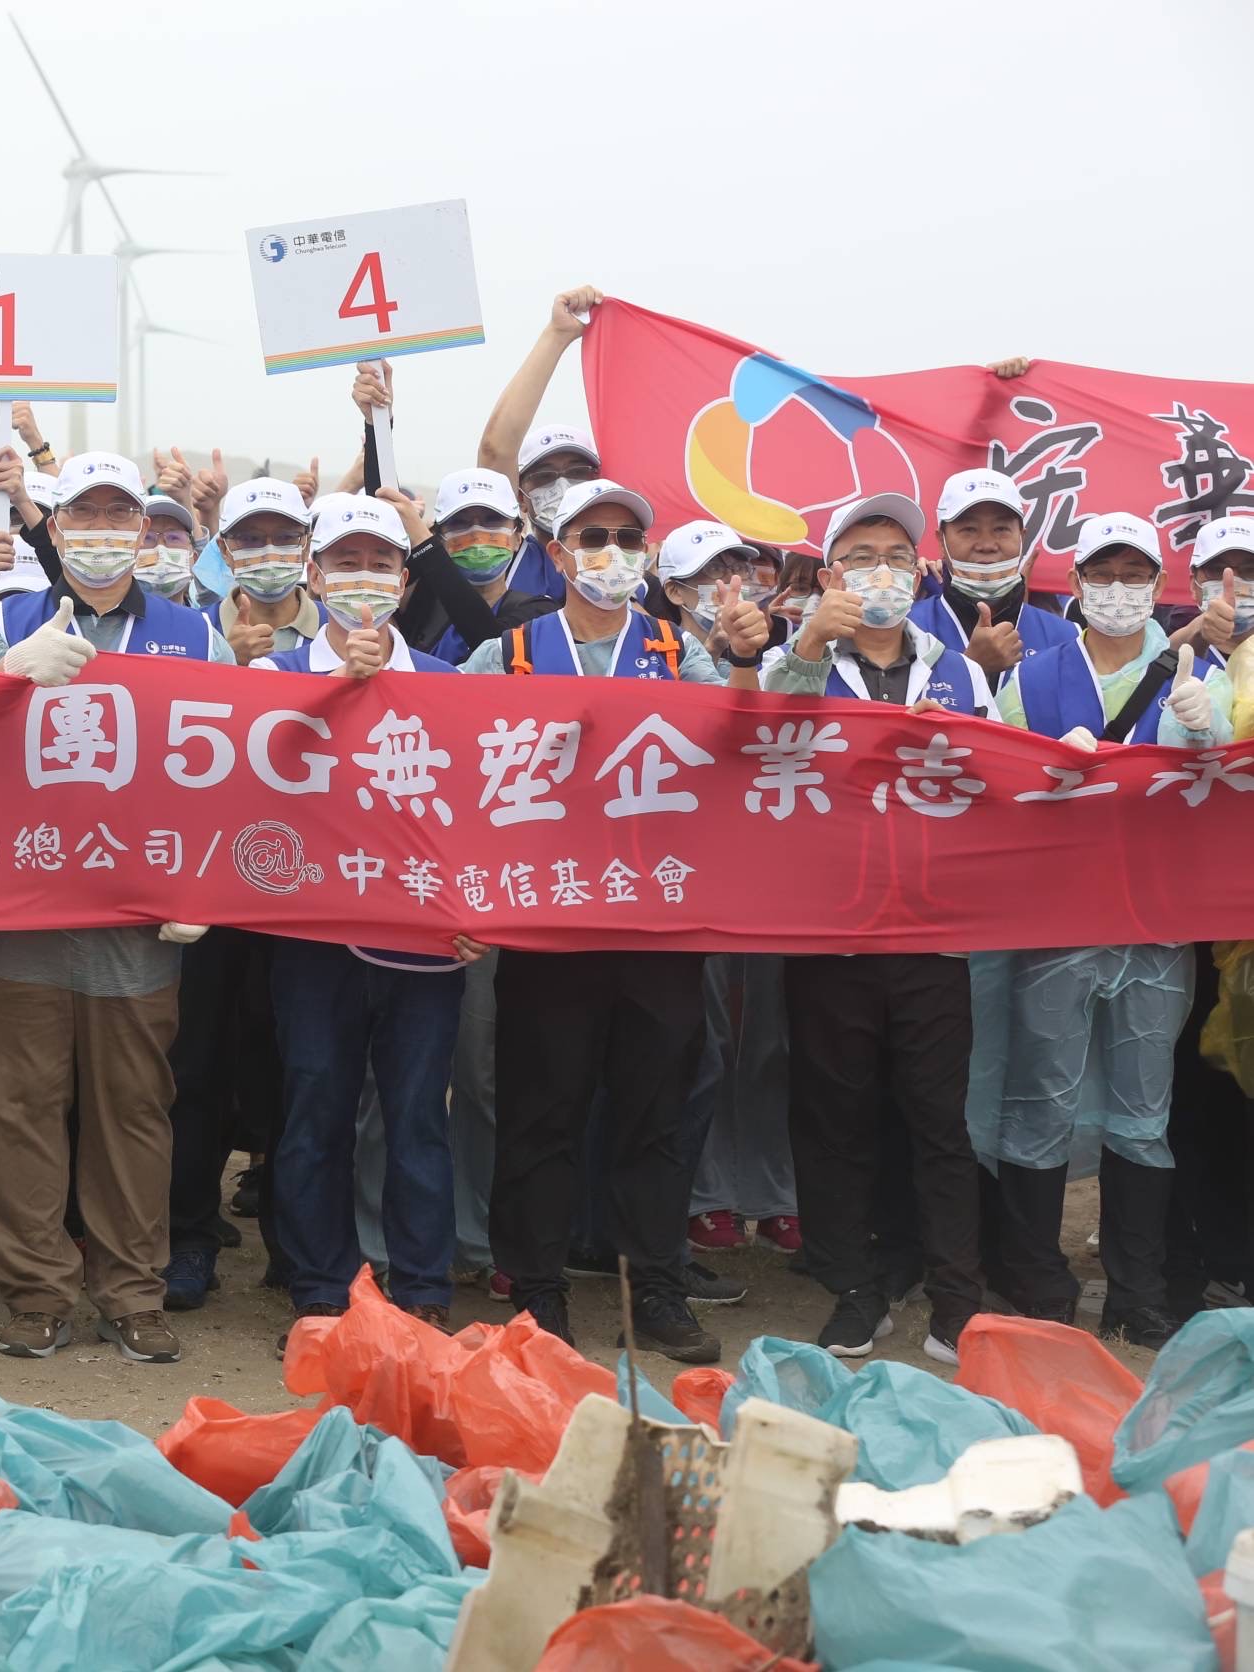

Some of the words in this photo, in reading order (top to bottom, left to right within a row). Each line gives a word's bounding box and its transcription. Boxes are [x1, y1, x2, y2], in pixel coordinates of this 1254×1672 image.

[293, 228, 346, 247] 中華電信
[338, 251, 398, 333] 4
[337, 846, 698, 913] 中華電信基金會
